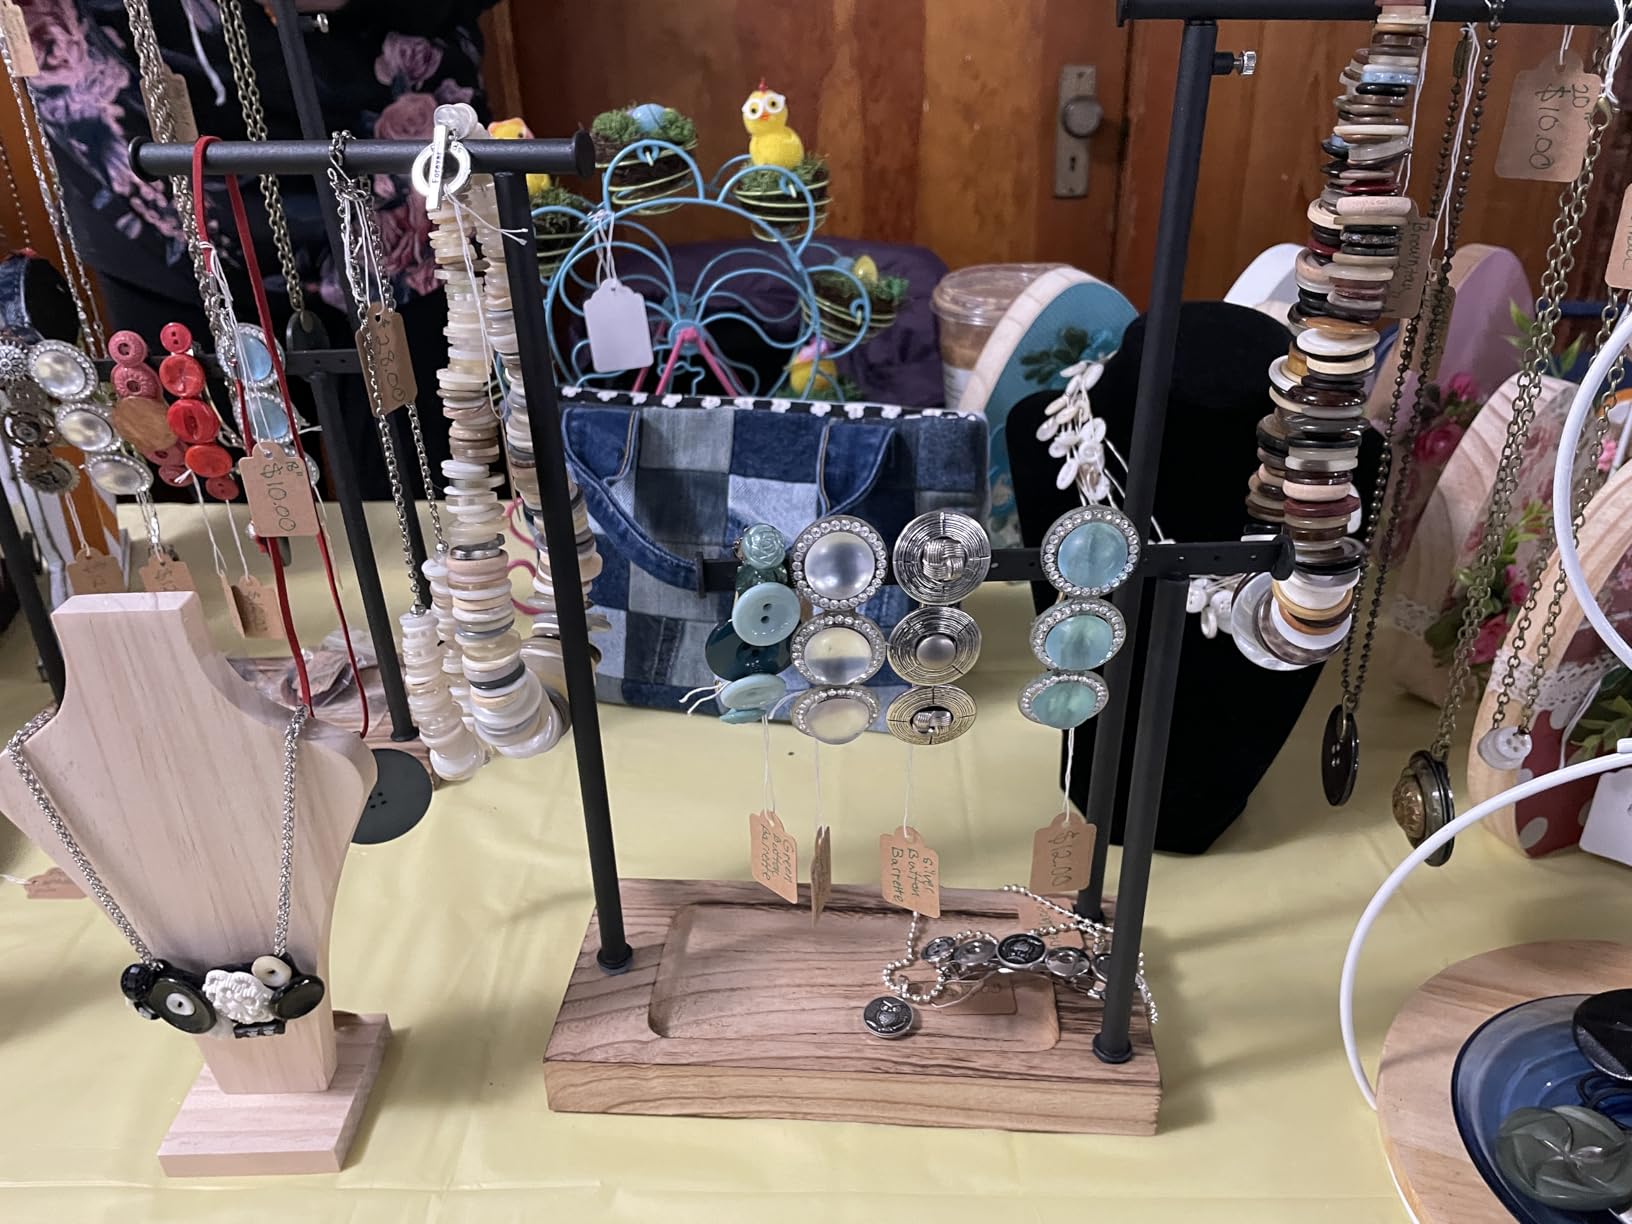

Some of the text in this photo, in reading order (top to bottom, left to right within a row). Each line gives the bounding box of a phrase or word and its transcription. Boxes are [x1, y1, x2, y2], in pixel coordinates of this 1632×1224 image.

[1529, 84, 1571, 169] $10.00
[432, 152, 442, 184] Forever
[260, 463, 297, 532] $10.00
[760, 824, 771, 881] Barrette
[782, 839, 794, 883] Green
[891, 847, 904, 903] Barrette
[908, 848, 922, 896] Button
[920, 857, 936, 894] Silver
[1049, 830, 1080, 888] $12.00
